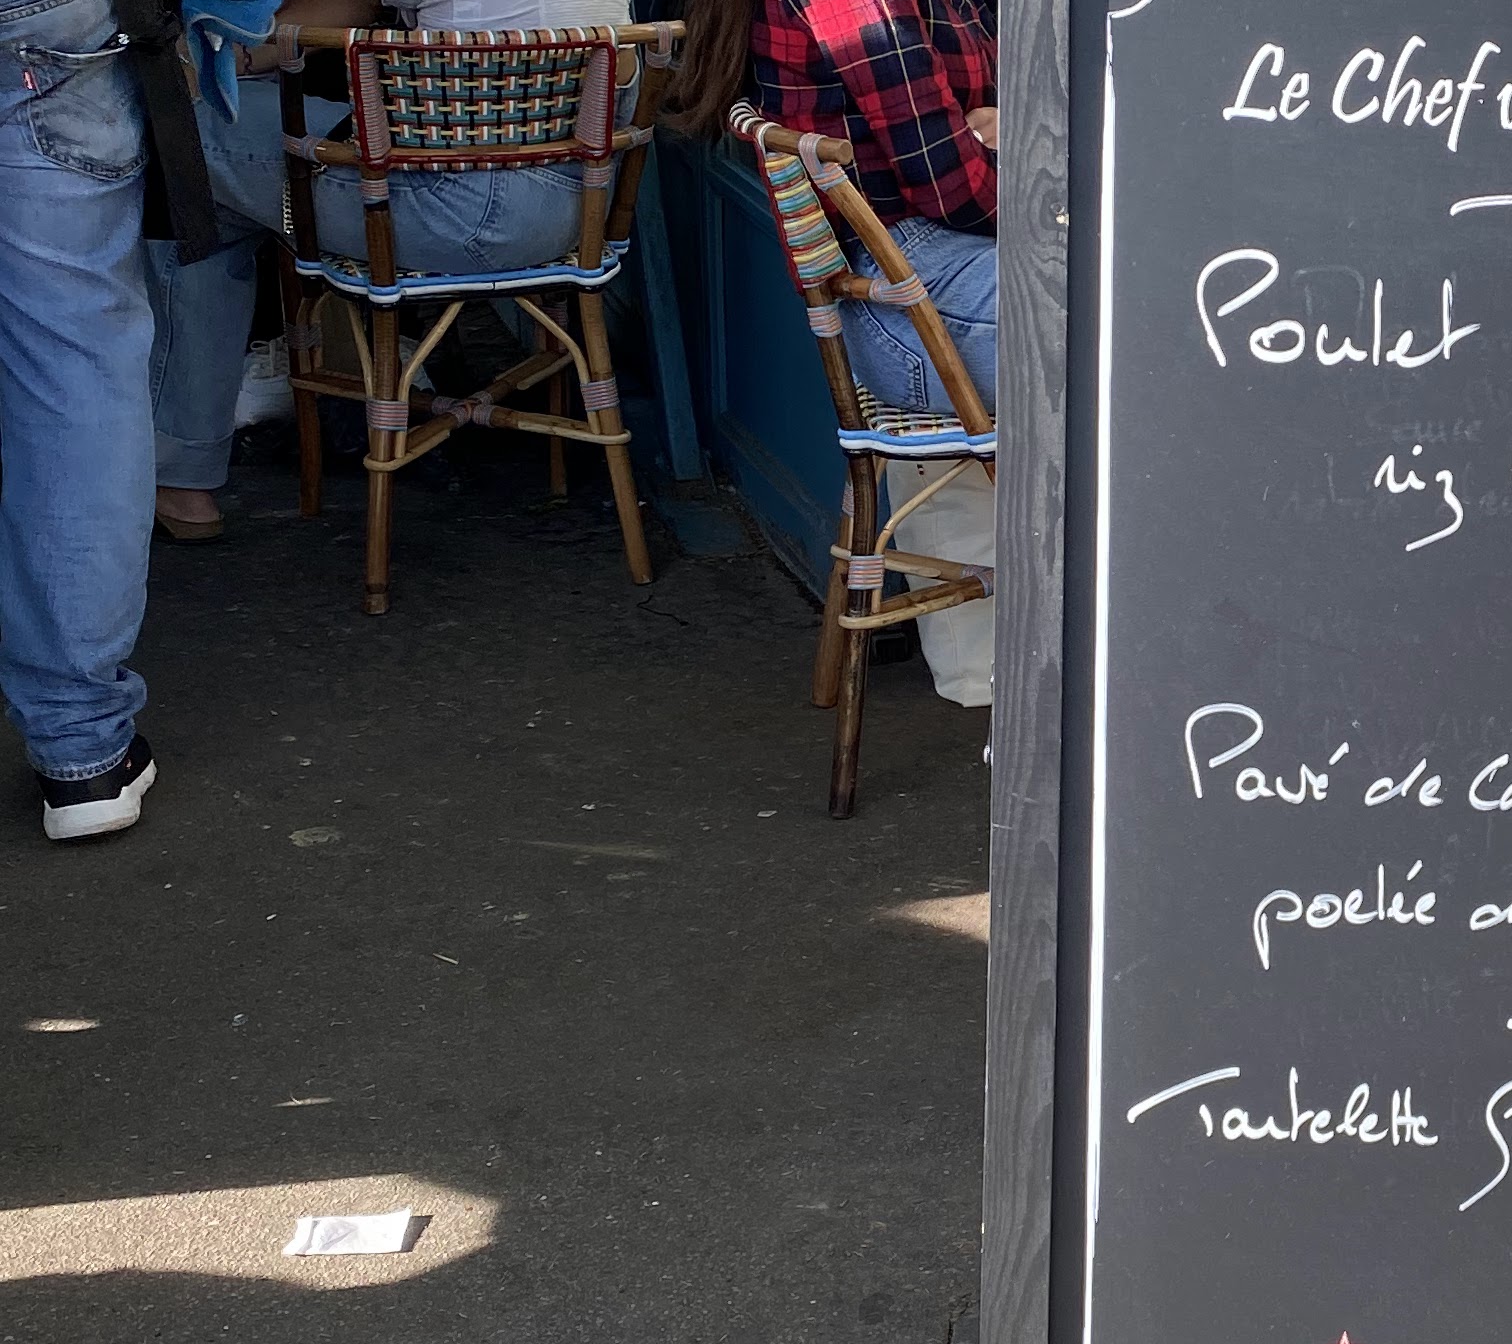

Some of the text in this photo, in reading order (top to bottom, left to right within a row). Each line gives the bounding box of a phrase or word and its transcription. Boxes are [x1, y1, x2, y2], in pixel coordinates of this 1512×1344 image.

[1224, 44, 1311, 123] Le
[1333, 37, 1495, 153] Chef
[1198, 250, 1480, 369] Poulet
[1375, 446, 1464, 552] riz
[1186, 704, 1350, 803] Pavé
[1366, 760, 1443, 807] de
[1128, 1068, 1439, 1146] Tartelette
